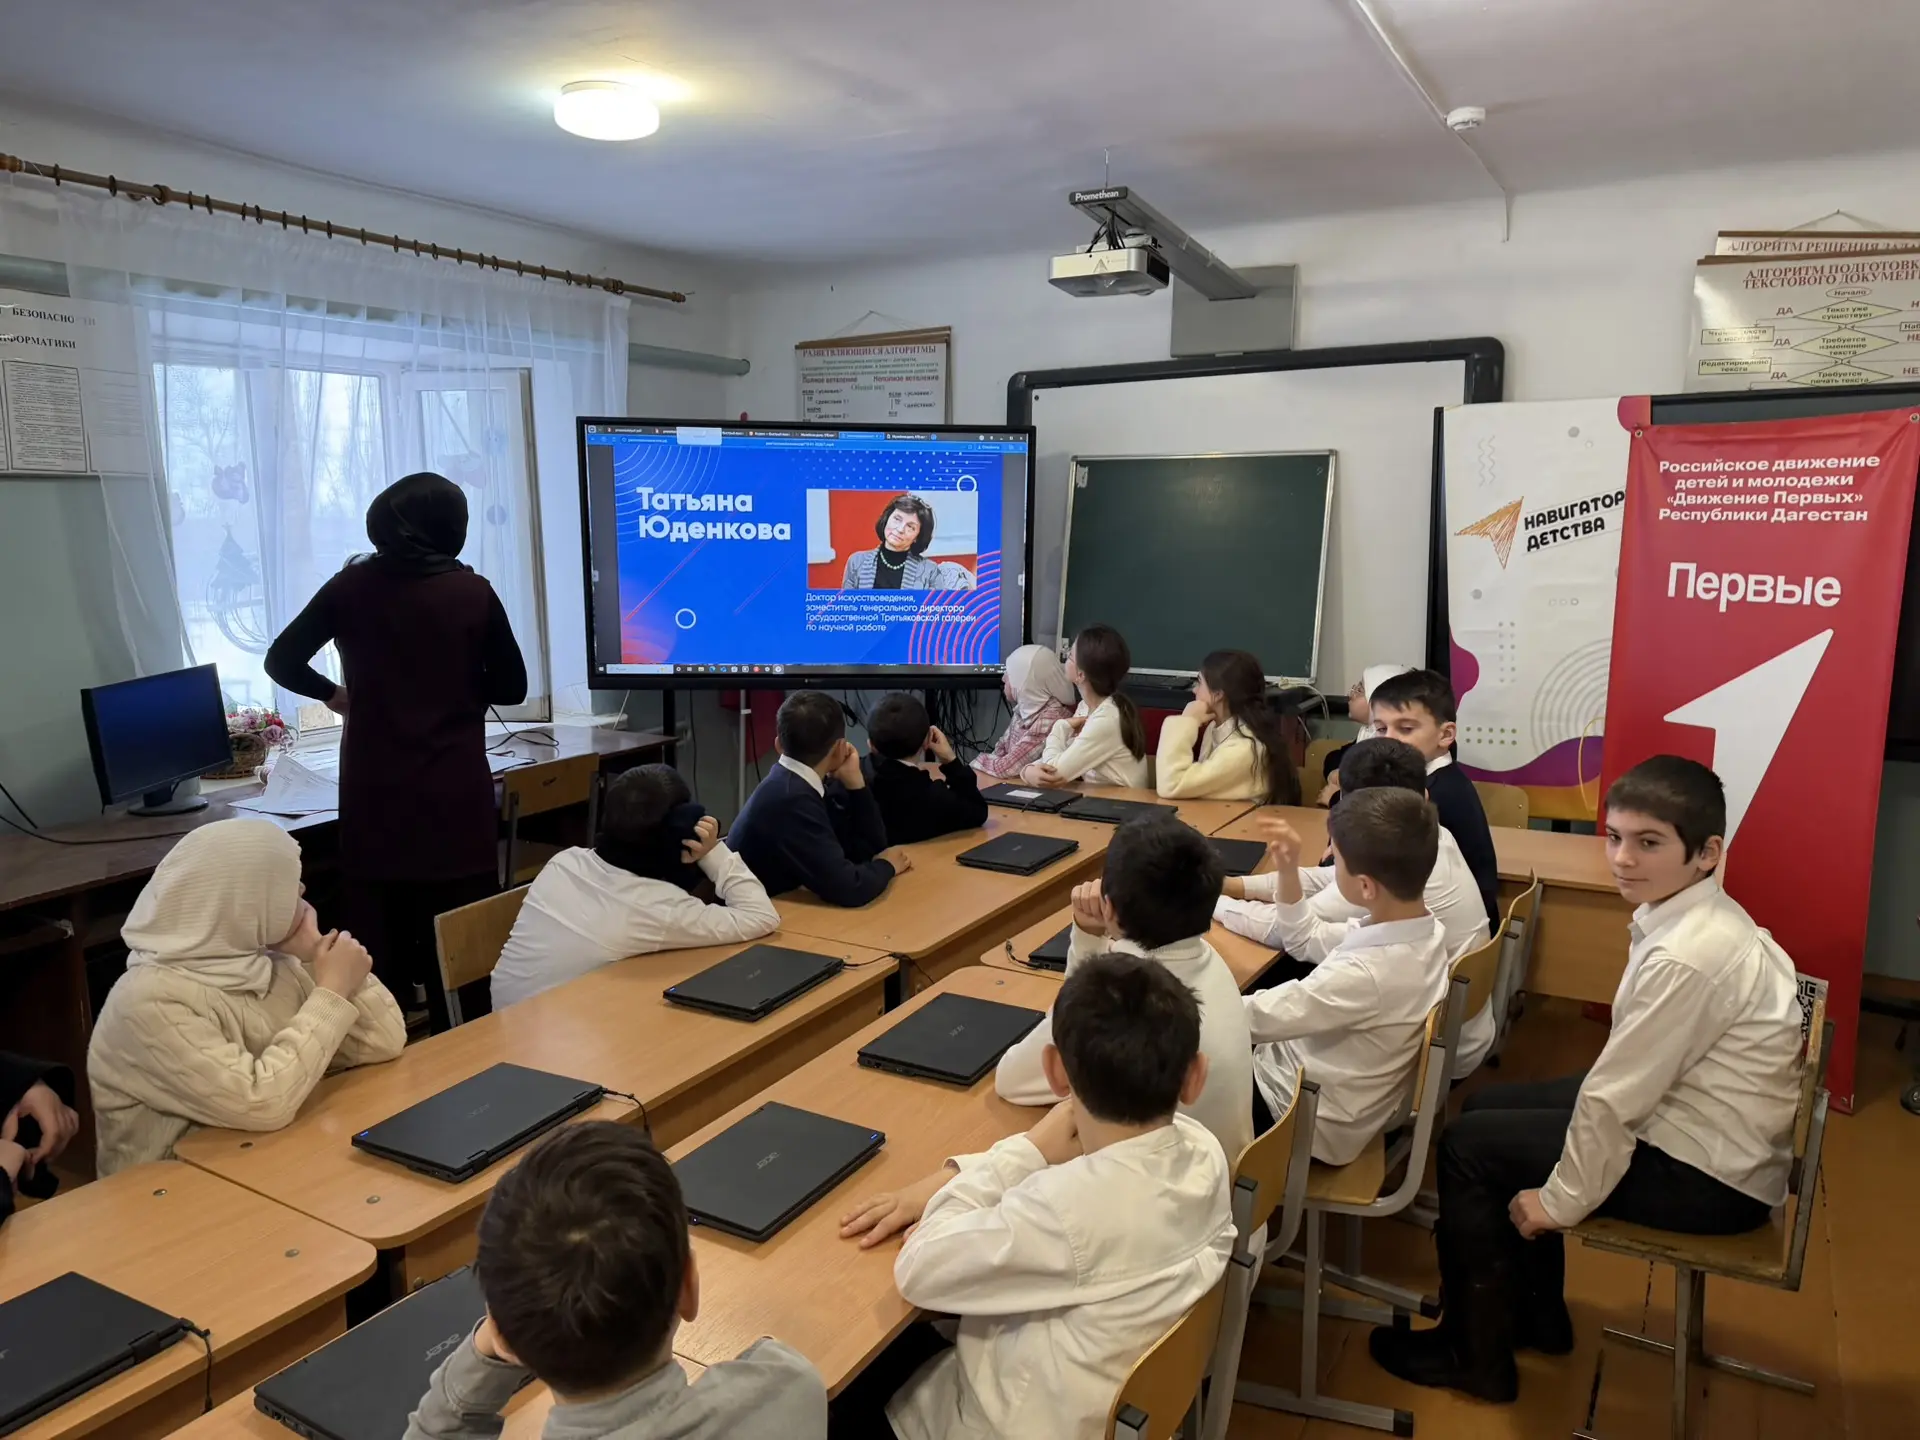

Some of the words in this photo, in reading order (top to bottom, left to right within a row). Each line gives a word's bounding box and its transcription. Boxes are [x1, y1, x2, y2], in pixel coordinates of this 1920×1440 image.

[1076, 190, 1119, 201] Promethean
[1728, 241, 1804, 252] АЛГОРИТМ
[1807, 241, 1880, 252] РЕШЕНИЯ
[1746, 265, 1824, 280] АЛГОРИТМ
[1743, 276, 1837, 289] ТЕКСТОВОГО
[1834, 288, 1867, 296] Начало
[1776, 307, 1793, 316] ДА
[1774, 339, 1791, 347] ДА
[803, 348, 885, 357] РАЗВЕТВЛЯЮЩИЕСЯ
[886, 346, 936, 355] АЛГОРИТМЫ
[1770, 371, 1788, 380] ДА
[1818, 371, 1862, 379] Требуется
[1659, 459, 1769, 473] Российское
[1772, 456, 1880, 472] движение
[1675, 475, 1728, 490] детей
[1732, 477, 1744, 487] и
[1748, 474, 1854, 489] молодежи
[636, 487, 753, 512] Татьяна
[1667, 492, 1769, 506] «Движение
[1773, 491, 1863, 507] Первых»
[1524, 490, 1625, 530] НАВИГАТОР
[1659, 508, 1767, 523] Республики
[1771, 508, 1868, 523] Дагестан
[638, 515, 791, 543] Юденкова
[1527, 517, 1605, 552] ДЕТСТВА
[1667, 561, 1841, 613] Первые
[806, 593, 836, 602] Доктор
[838, 594, 916, 603] искусствоведения,
[806, 604, 858, 612] заместитель
[860, 605, 918, 613] генерального
[919, 605, 965, 613] директора
[806, 614, 879, 622] Государственной
[881, 614, 940, 622] Третьяковской
[818, 624, 854, 632] научной
[856, 624, 886, 632] работе
[425, 1333, 461, 1361] acer
